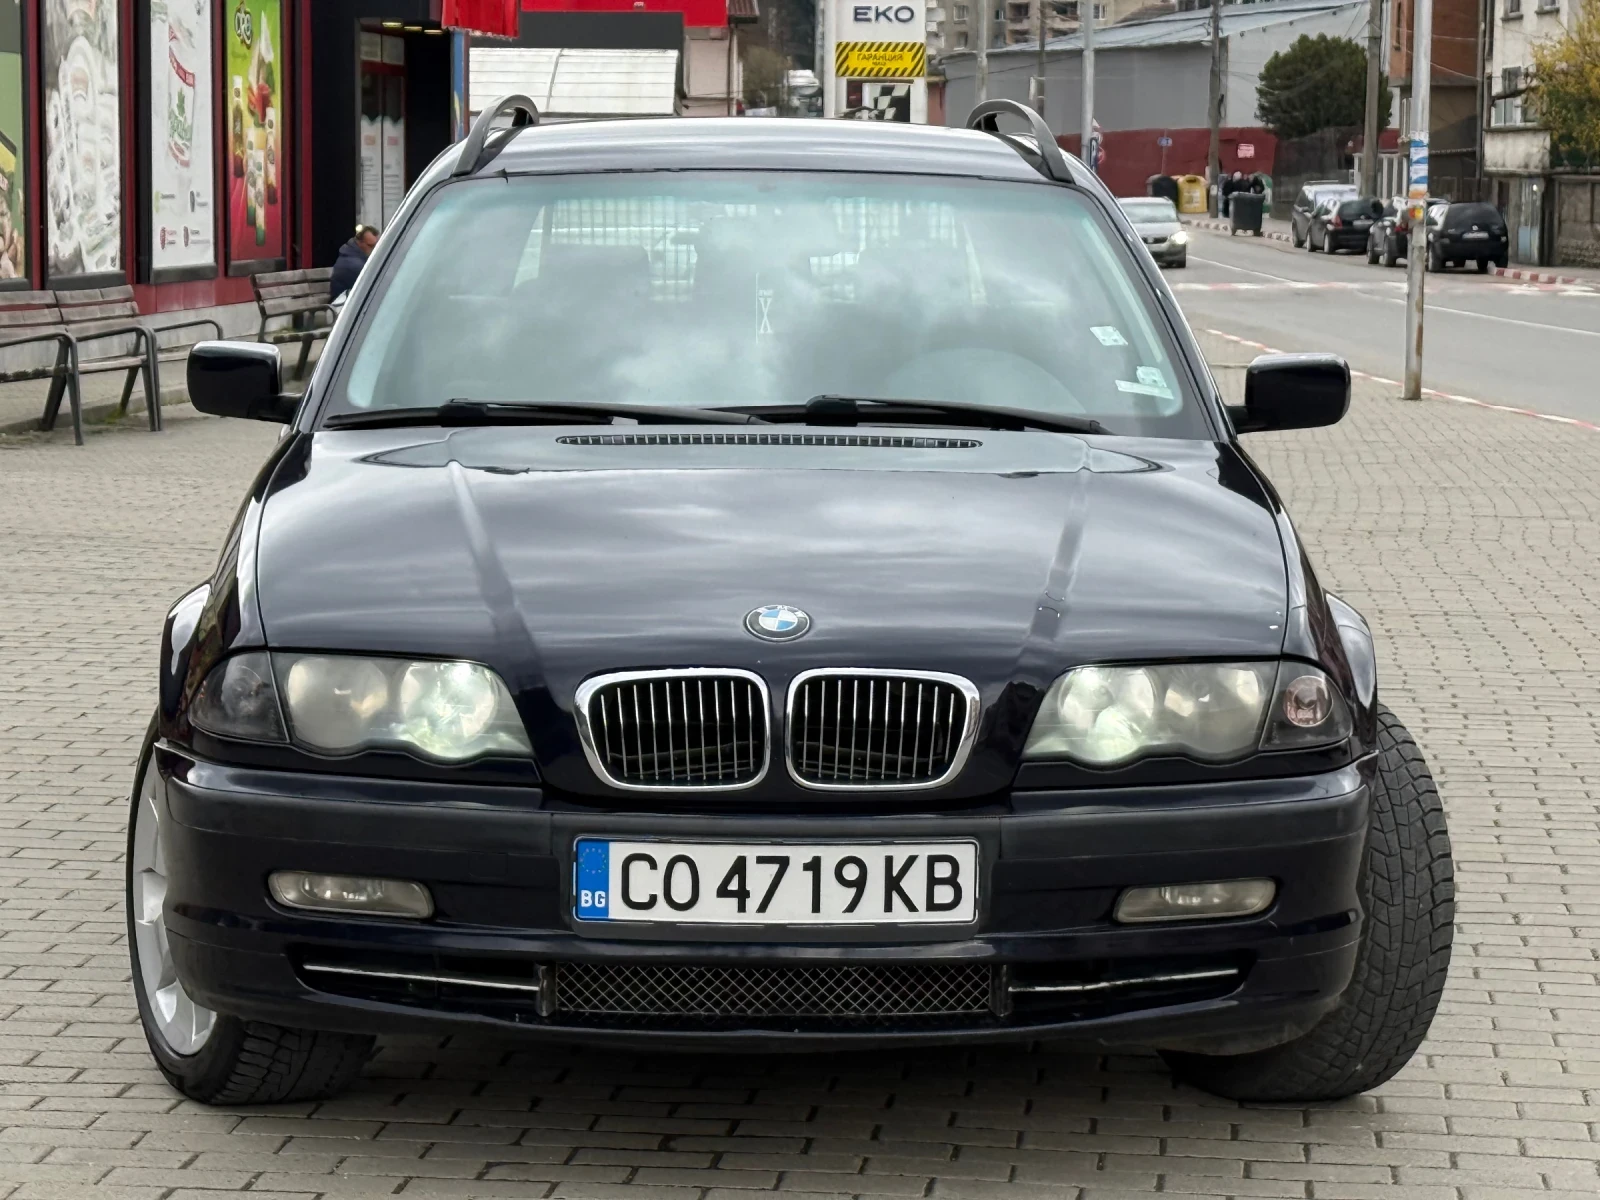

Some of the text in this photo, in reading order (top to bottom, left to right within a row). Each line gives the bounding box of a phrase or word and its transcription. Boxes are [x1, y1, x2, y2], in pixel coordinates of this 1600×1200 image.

[853, 5, 914, 23] EKO
[857, 53, 903, 62] ГАРАНЦИЯ
[716, 854, 868, 914] 4719
[581, 889, 606, 908] BG
